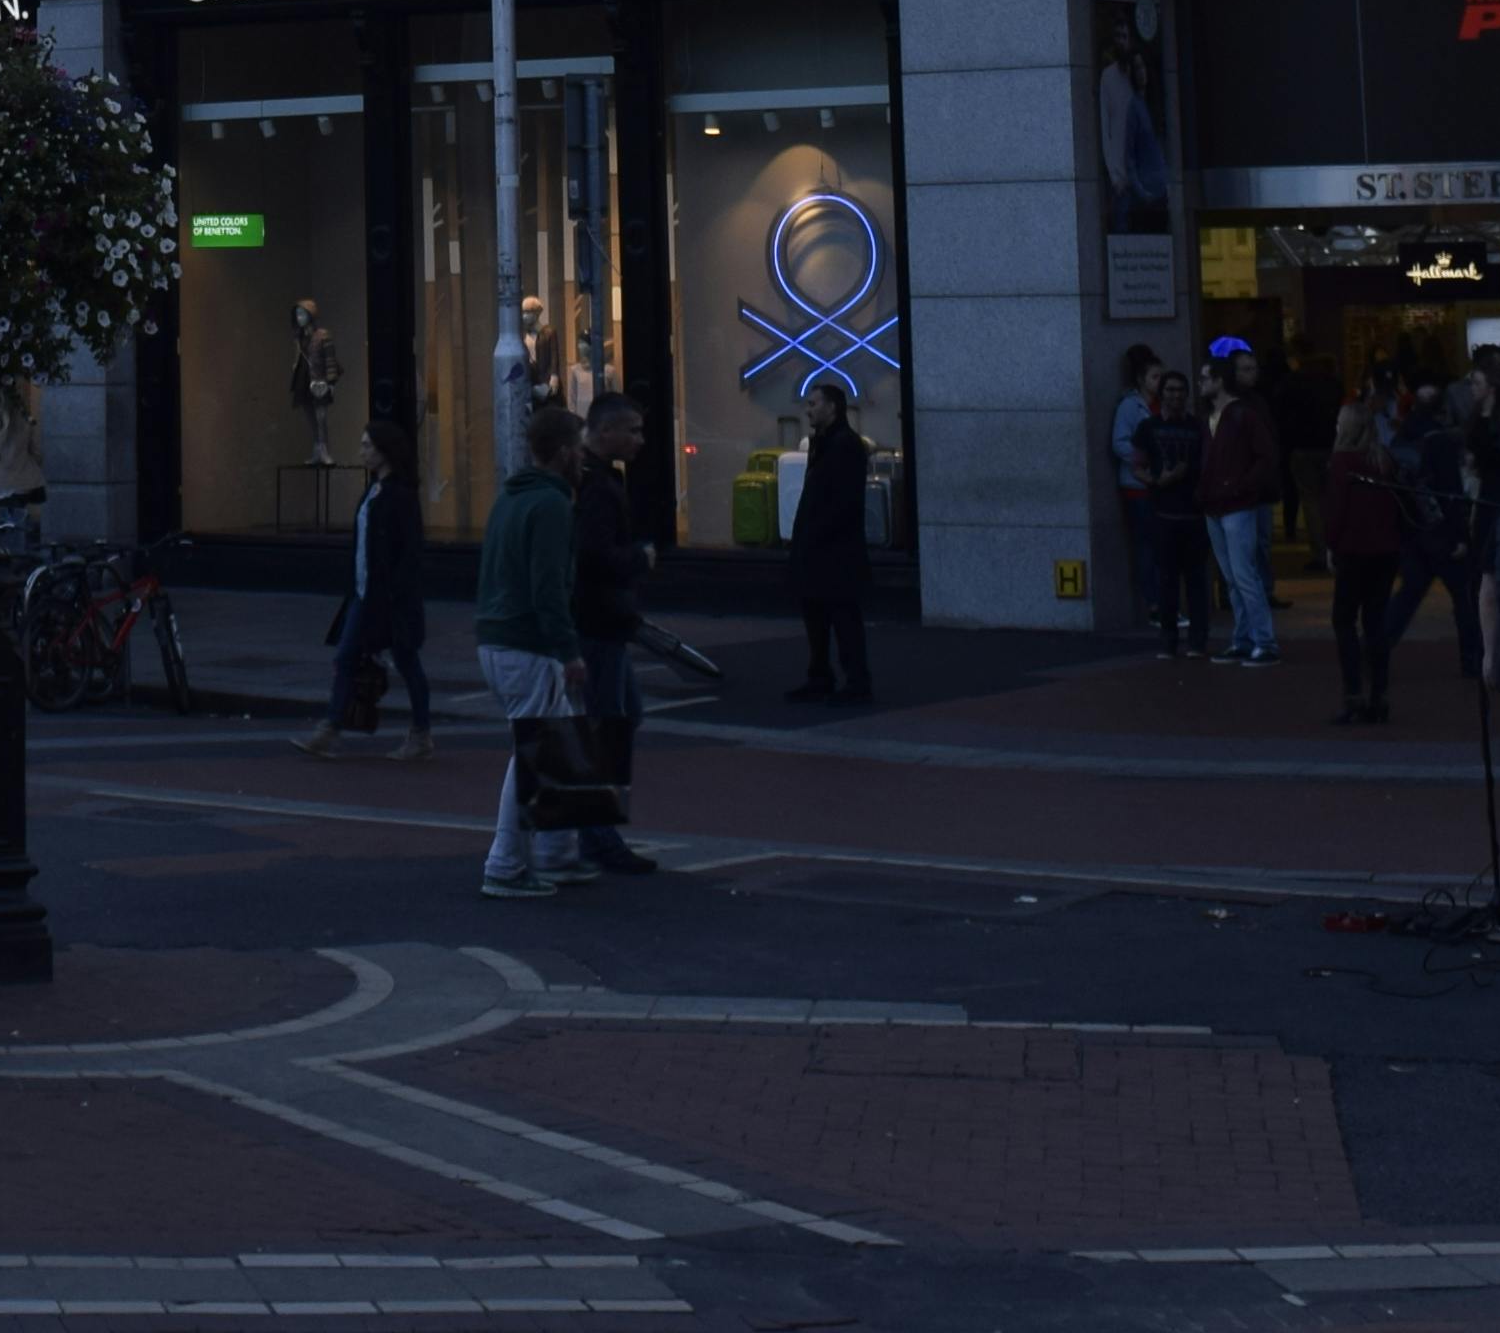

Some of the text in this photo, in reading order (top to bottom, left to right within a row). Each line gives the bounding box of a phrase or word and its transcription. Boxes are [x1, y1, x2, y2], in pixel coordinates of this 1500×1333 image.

[1356, 172, 1407, 200] ST.
[193, 216, 248, 226] UNITED COLORS
[1405, 261, 1484, 287] Hallmark
[1060, 566, 1078, 593] H
